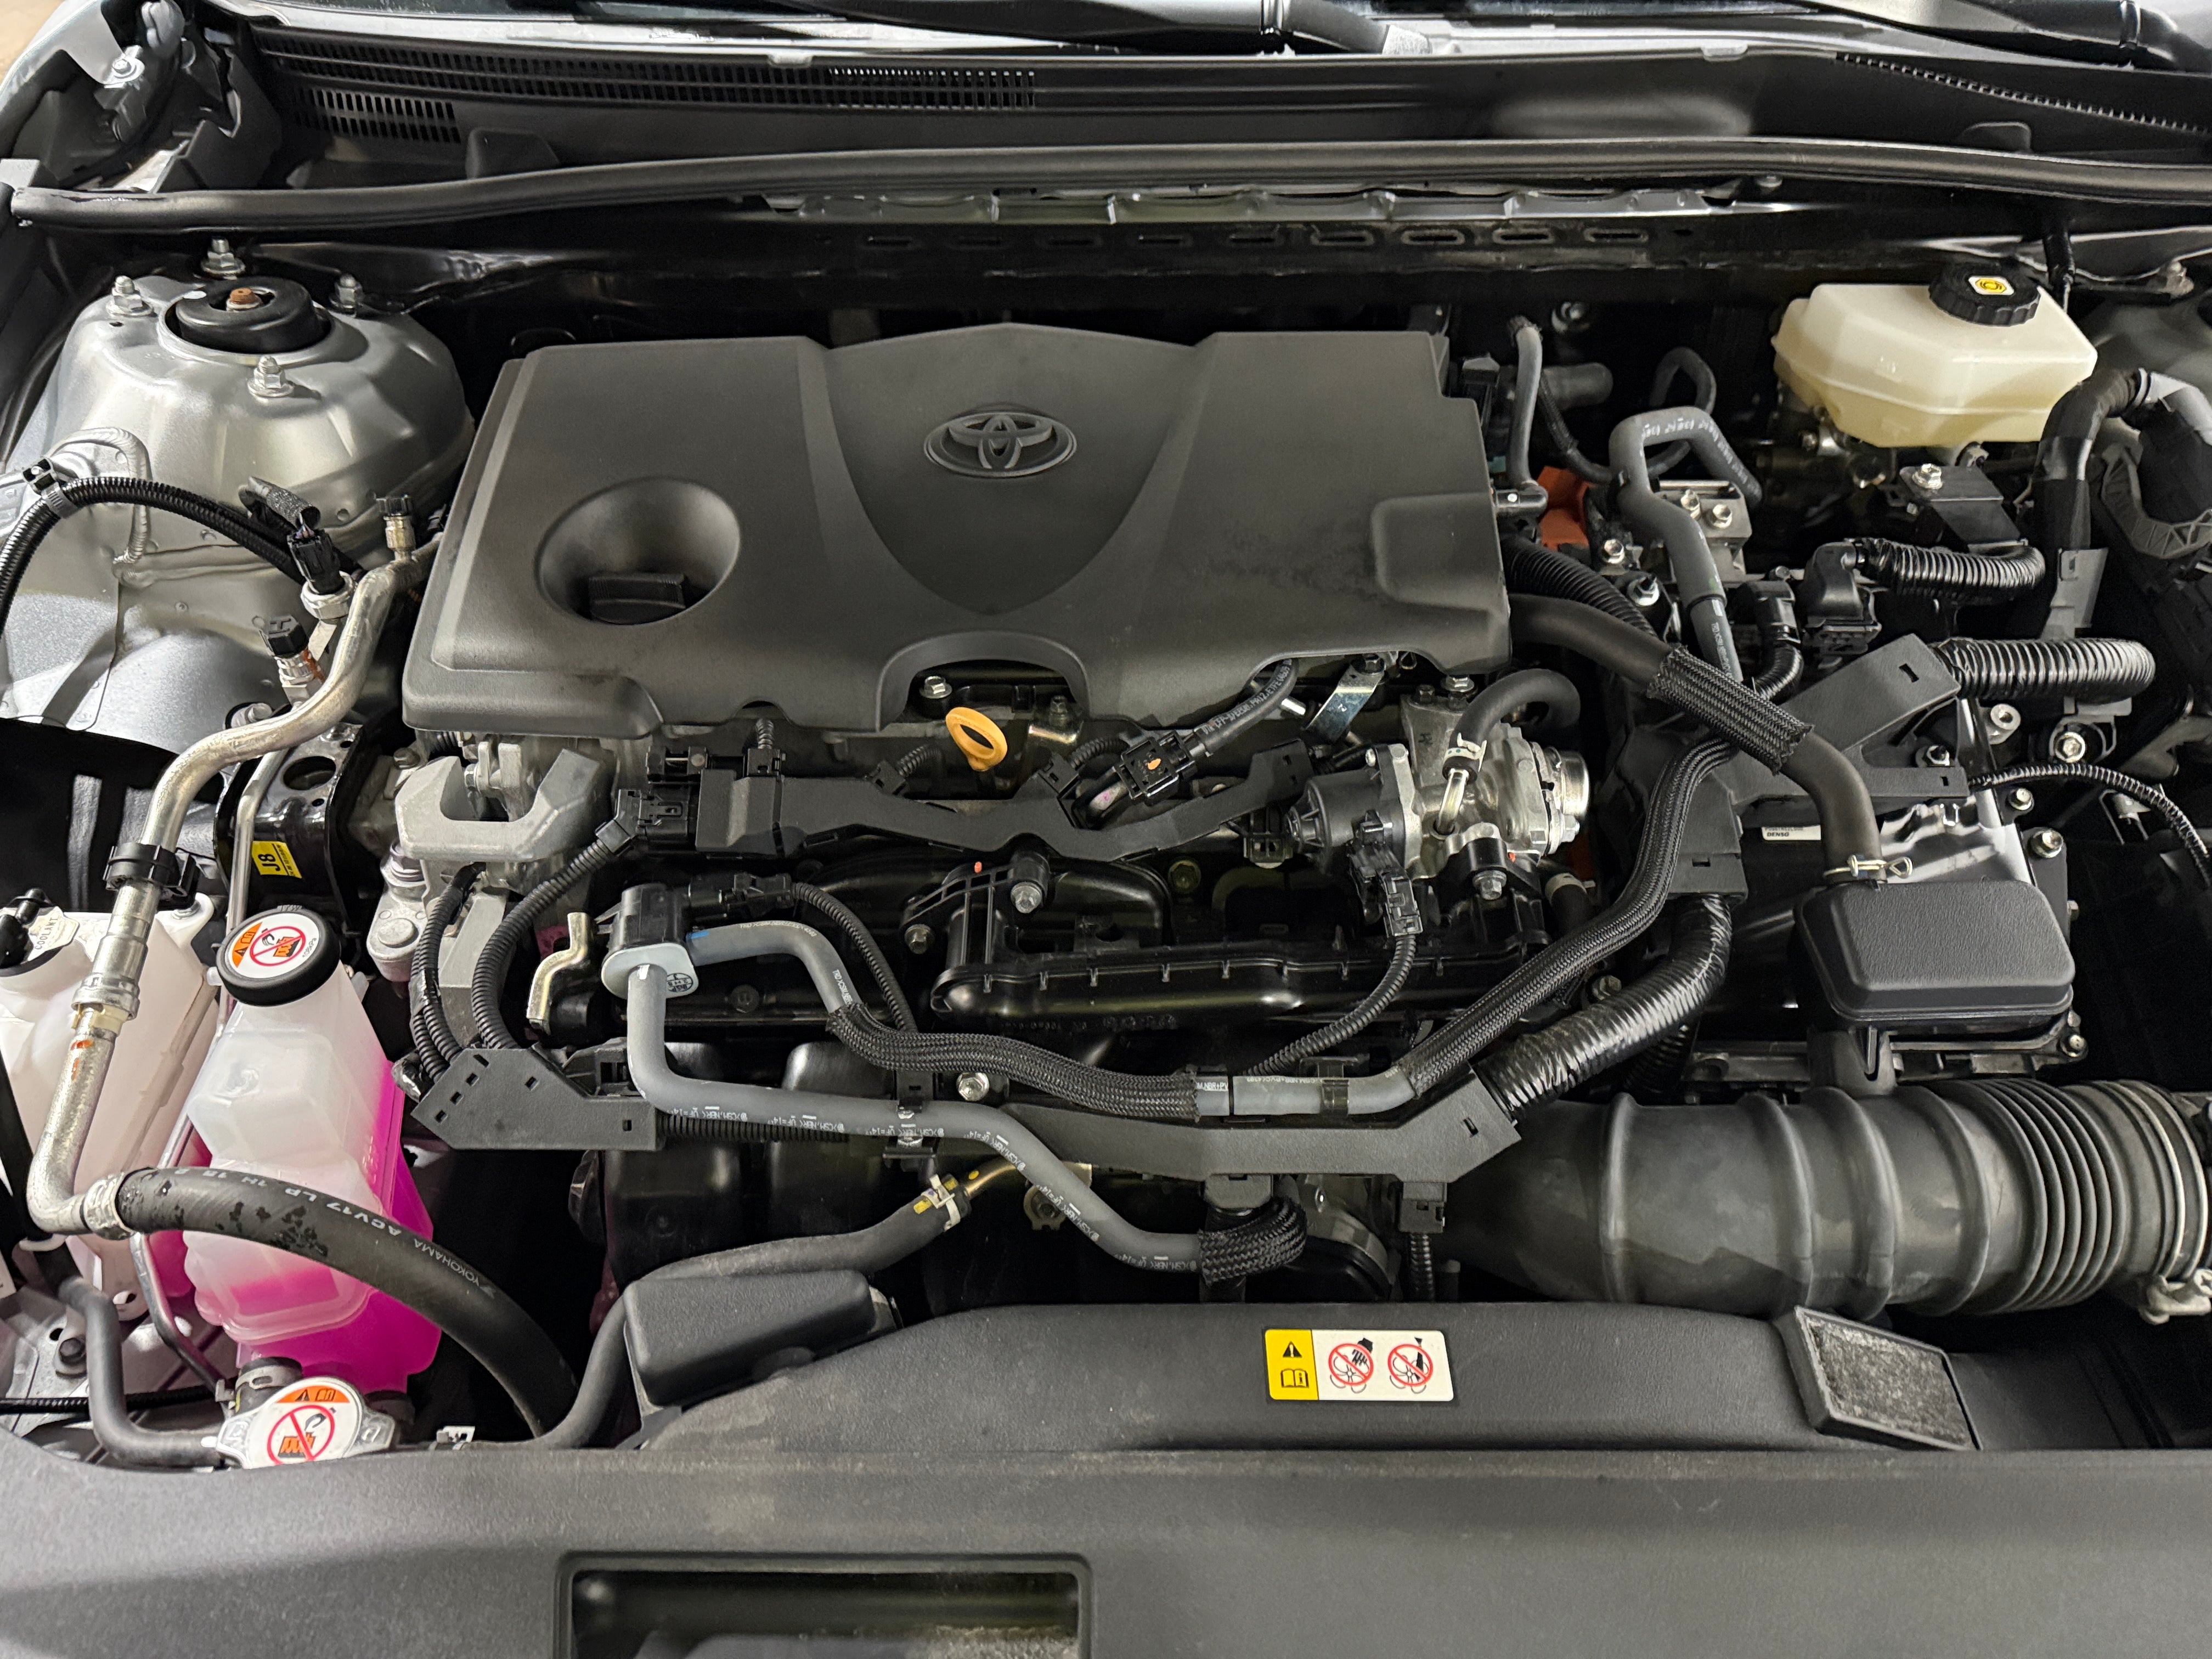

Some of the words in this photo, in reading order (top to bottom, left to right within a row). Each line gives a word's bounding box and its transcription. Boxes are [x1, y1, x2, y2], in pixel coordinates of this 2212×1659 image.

[258, 854, 280, 871] J8
[34, 917, 58, 950] COOLANT
[285, 1187, 317, 1202] LP
[414, 1238, 479, 1287] YOKOHAMA
